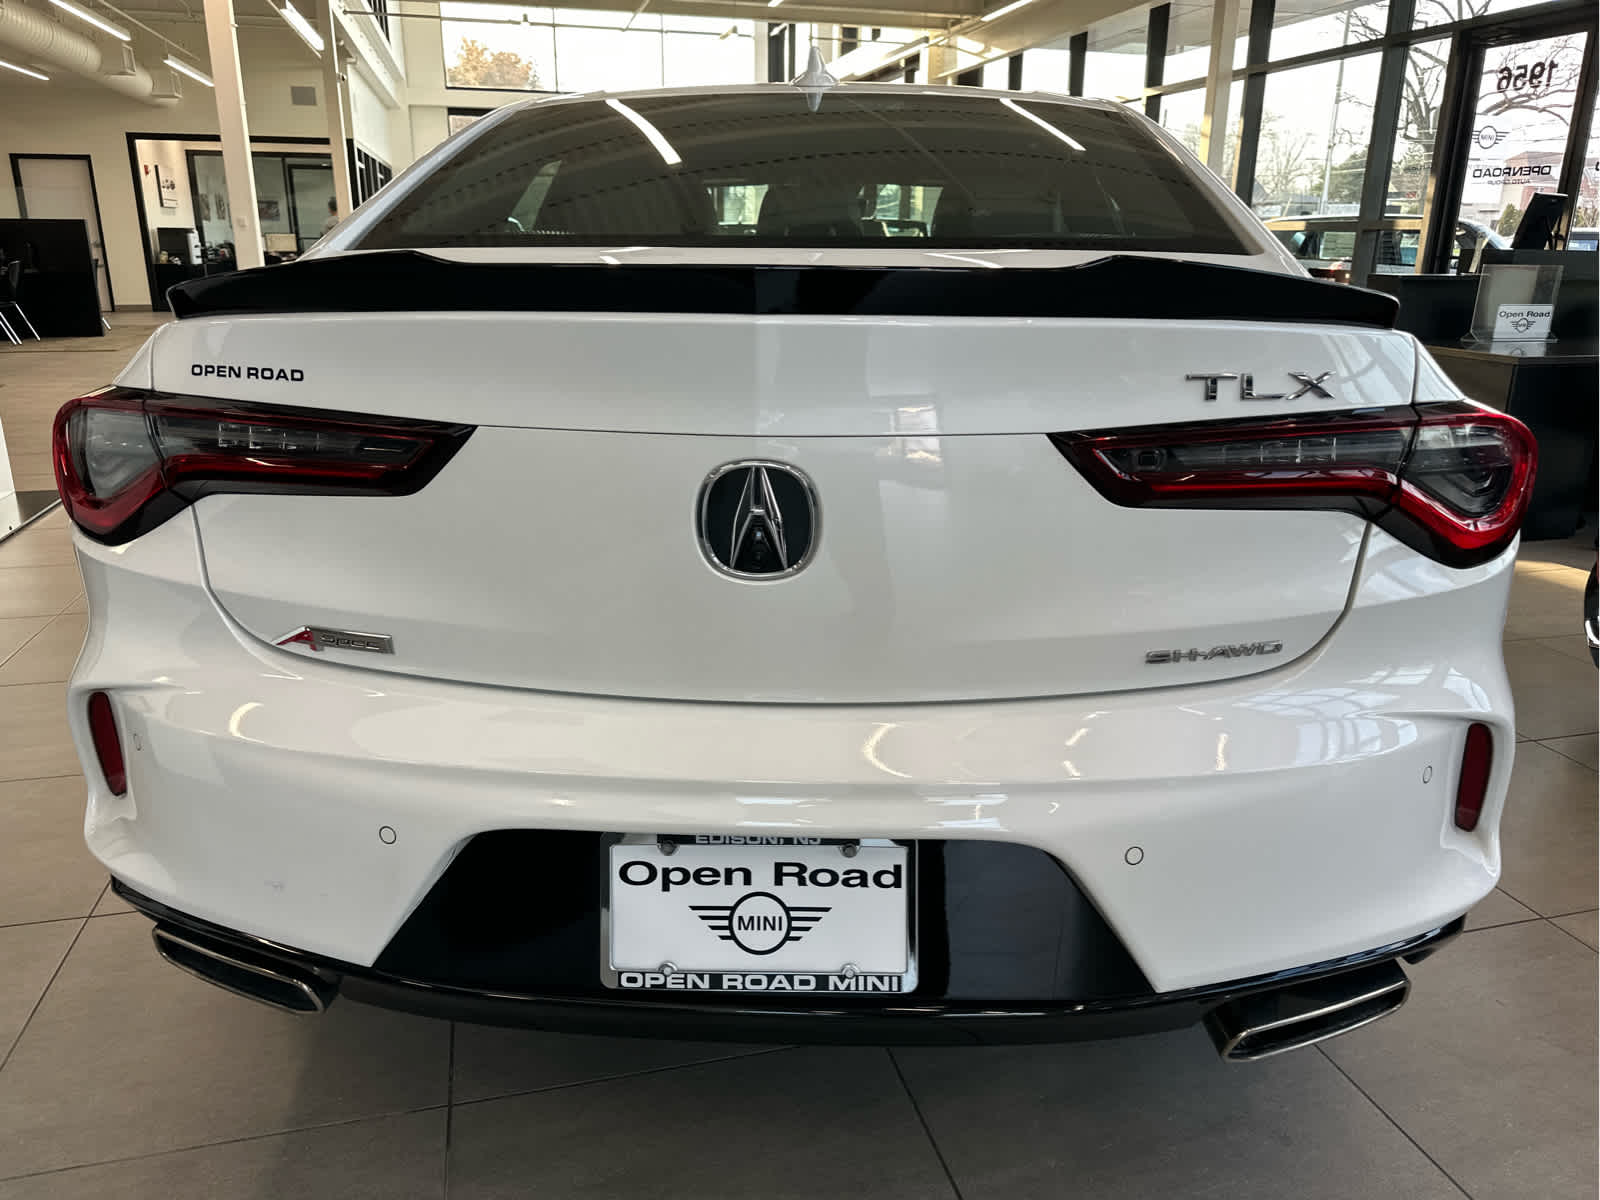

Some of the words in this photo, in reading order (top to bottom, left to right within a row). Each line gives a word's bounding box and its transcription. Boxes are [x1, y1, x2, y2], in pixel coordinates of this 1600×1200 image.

[1499, 311, 1524, 319] Open
[1526, 310, 1551, 318] Road
[191, 364, 241, 378] OPEN
[247, 367, 304, 382] ROAD
[1185, 371, 1336, 401] TLX
[1145, 640, 1283, 664] SH-AWD
[695, 835, 784, 845] EDISON,
[793, 837, 821, 845] NJ
[618, 860, 752, 892] Open
[773, 861, 902, 889] Road
[737, 915, 783, 931] MINI
[620, 972, 710, 989] OPEN
[722, 974, 817, 991] ROAD
[828, 975, 899, 992] MINI
